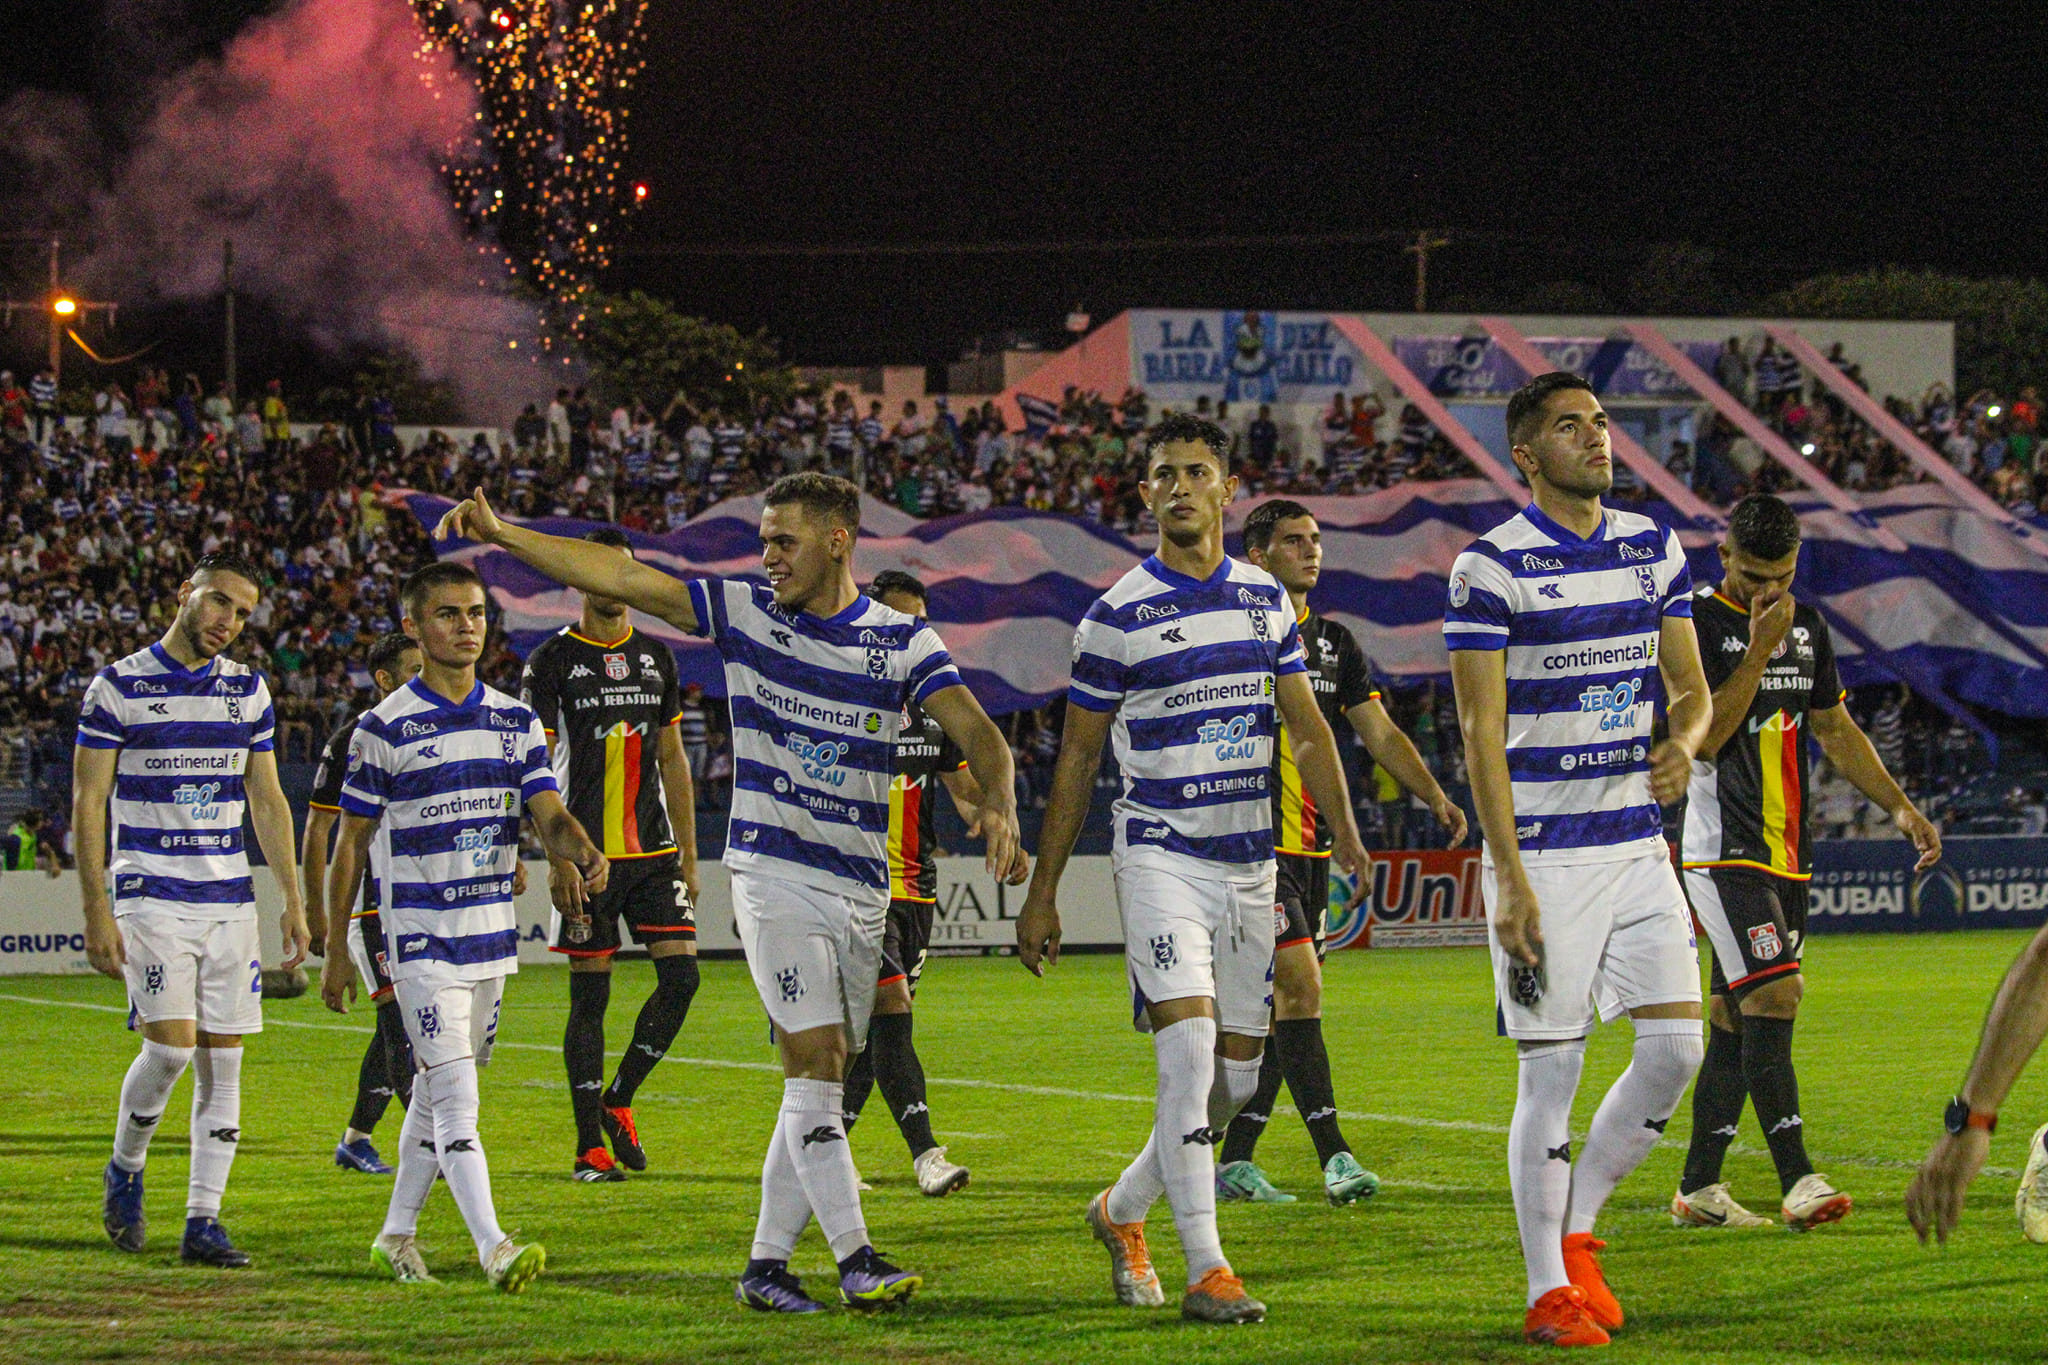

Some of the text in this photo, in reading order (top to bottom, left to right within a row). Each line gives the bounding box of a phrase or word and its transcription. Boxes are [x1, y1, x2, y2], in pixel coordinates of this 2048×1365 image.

[1160, 318, 1214, 349] LA
[1280, 321, 1336, 350] DEL
[1618, 542, 1655, 560] FINCA
[1522, 553, 1565, 571] FINCA
[1238, 587, 1272, 605] FINCA
[1136, 603, 1180, 621] FINCA
[860, 628, 899, 646] FINCA
[1543, 640, 1648, 671] continental
[1164, 678, 1262, 709] continental
[575, 696, 600, 710] SAN
[757, 683, 860, 729] continental
[401, 720, 439, 738] FINCA
[1215, 742, 1256, 762] GRAU
[1578, 748, 1632, 767] FLEMIN
[145, 754, 228, 770] continental
[1200, 776, 1257, 795] FLEMING
[1812, 871, 1905, 885] HOPPING
[1807, 886, 1904, 916] DUBAI
[931, 924, 984, 940] OTEL
[0, 934, 86, 953] GRUPO
